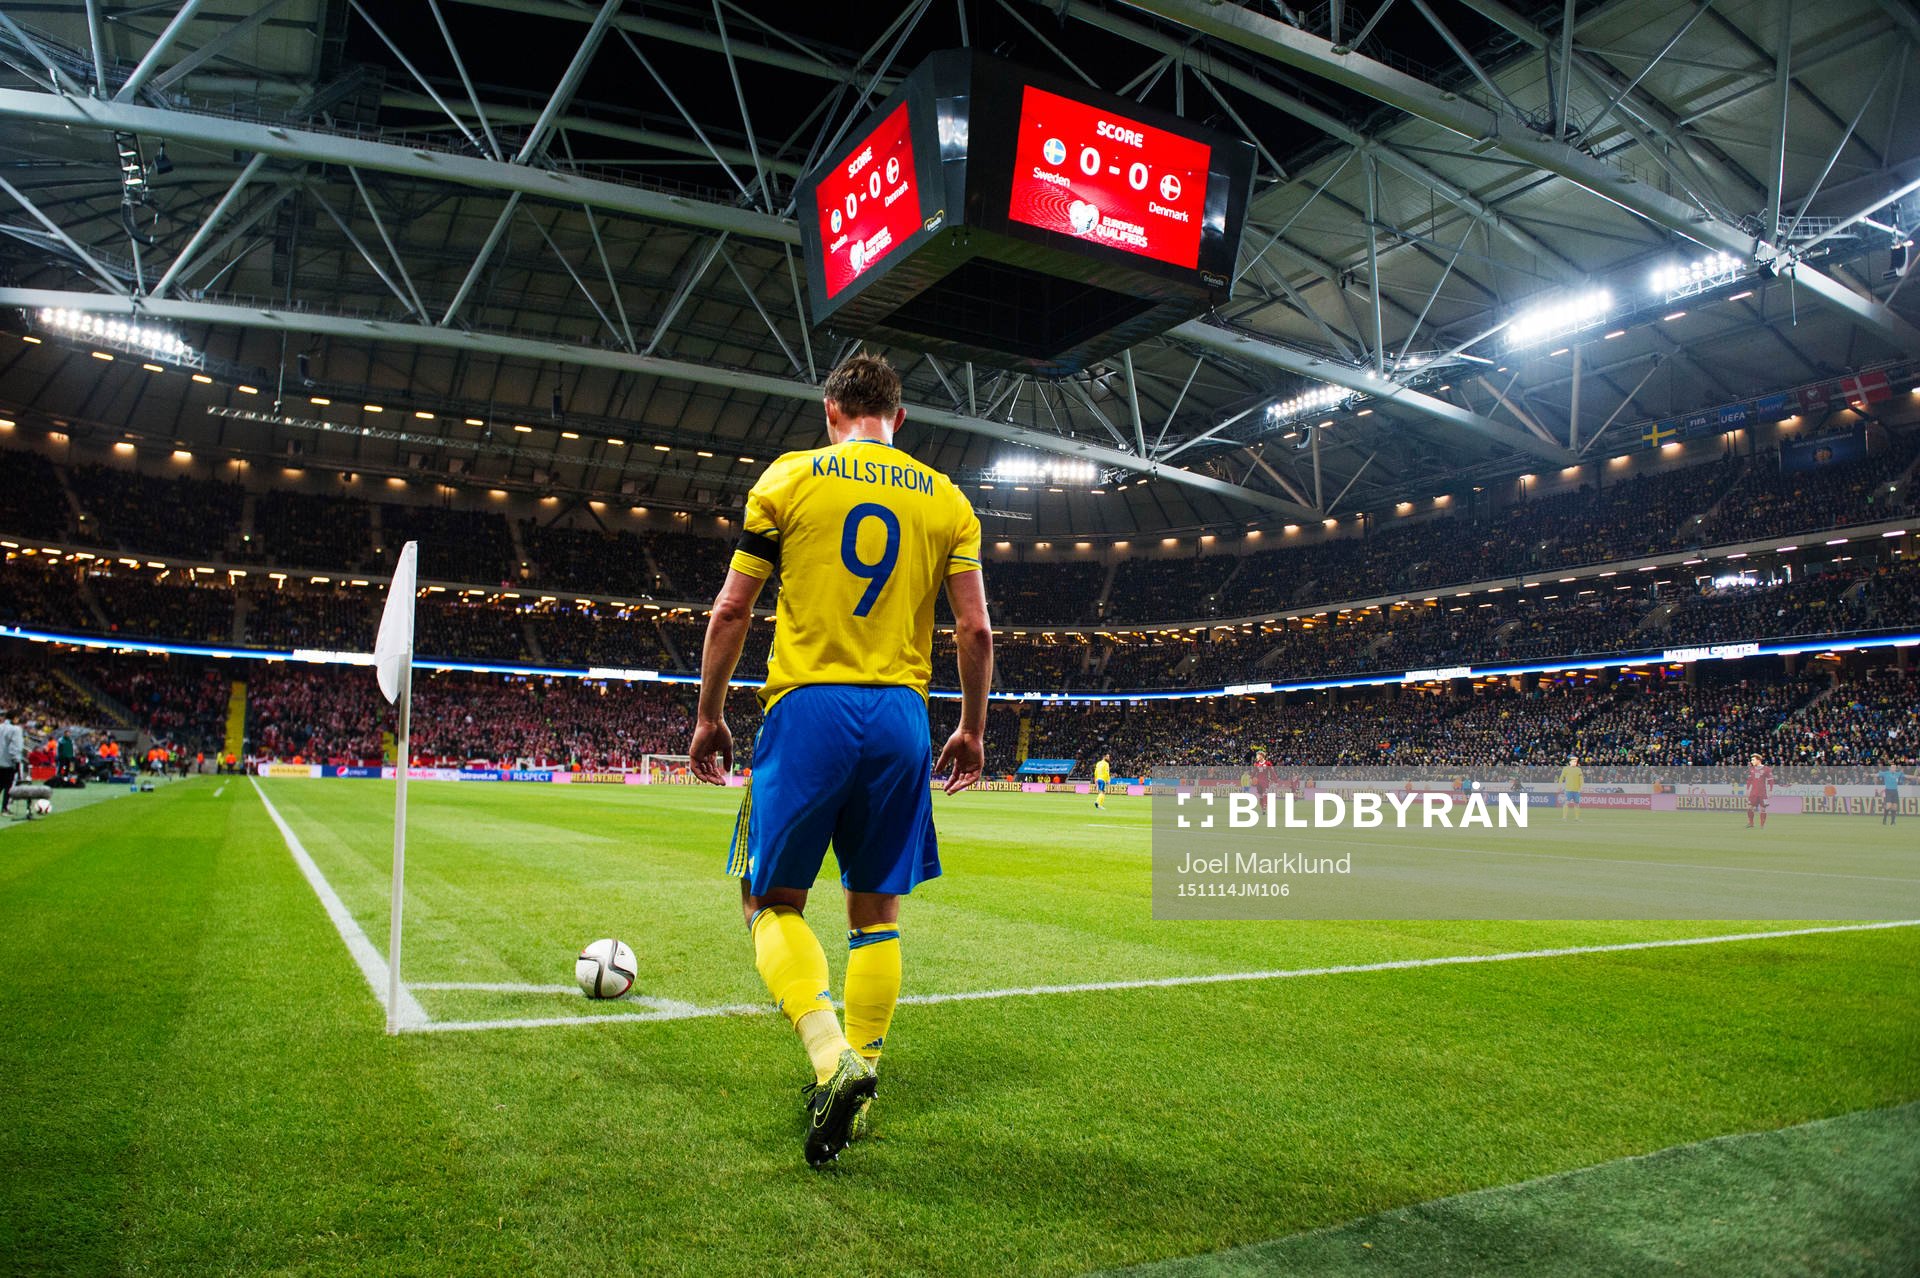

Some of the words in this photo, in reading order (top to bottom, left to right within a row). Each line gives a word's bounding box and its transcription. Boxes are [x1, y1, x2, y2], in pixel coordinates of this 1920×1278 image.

[1096, 121, 1144, 148] SCORE
[848, 146, 873, 179] SCORE
[1079, 147, 1101, 176] 0
[1128, 162, 1149, 191] 0
[1033, 167, 1071, 188] Sweden
[846, 193, 857, 220] 0
[869, 171, 881, 199] 0
[1149, 201, 1189, 223] Denmark
[1096, 223, 1148, 248] QUALIFIERS
[1102, 216, 1145, 237] EUROPEAN
[1689, 417, 1706, 427] FIFA
[1720, 411, 1745, 424] UEFA
[812, 452, 934, 497] KÄLLSTRÖM
[840, 502, 901, 618] 9
[513, 772, 550, 781] RESPECT
[571, 773, 591, 783] HEJA
[592, 773, 625, 784] SVERIGE
[652, 774, 676, 785] HEJA
[988, 781, 1022, 791] SVERIGE
[1579, 796, 1607, 804] ROPEAN
[1608, 797, 1650, 806] QUALIFIERS
[1676, 797, 1705, 809] HEJA
[1707, 797, 1750, 810] SVERIG
[1802, 797, 1847, 813] HEJA
